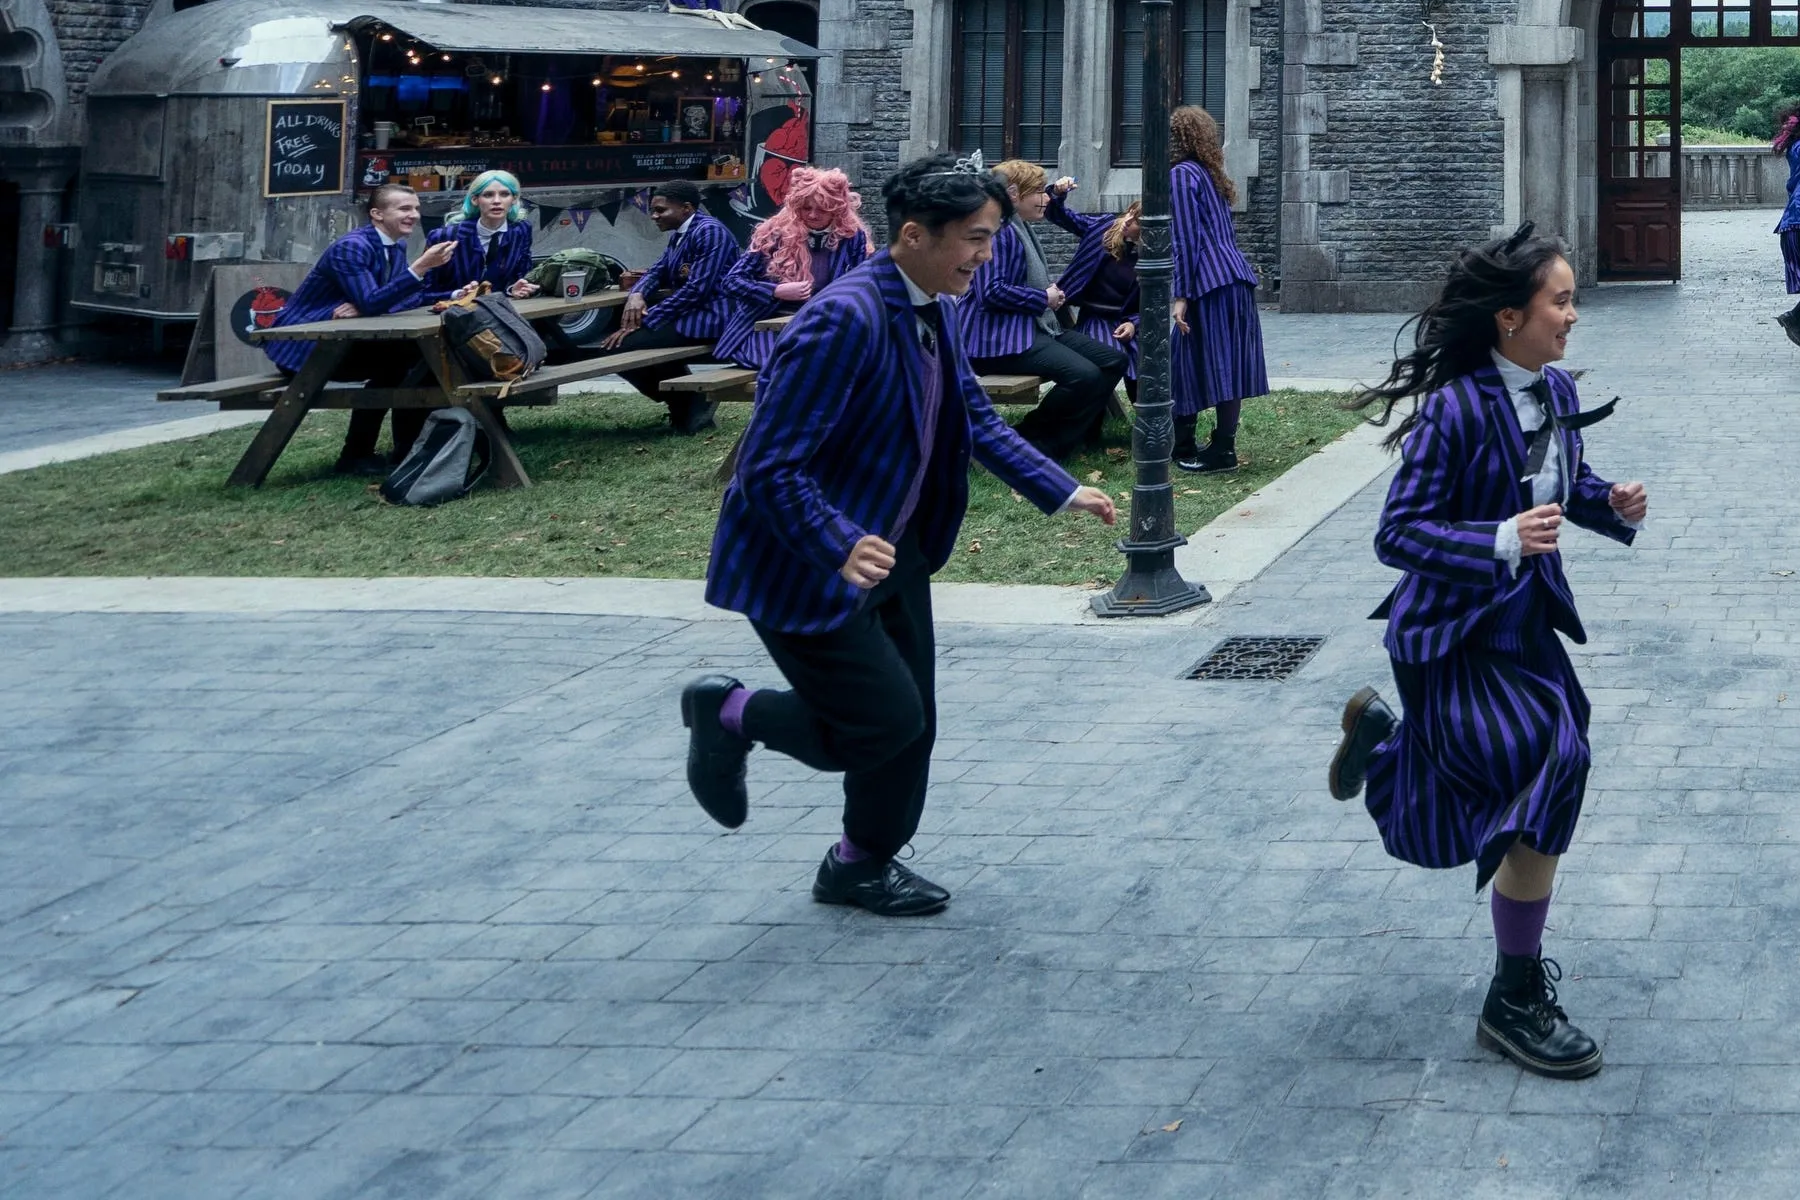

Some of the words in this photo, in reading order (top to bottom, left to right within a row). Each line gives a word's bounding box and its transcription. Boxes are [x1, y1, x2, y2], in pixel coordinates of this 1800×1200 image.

[275, 114, 304, 128] ALL
[304, 114, 341, 138] DRINKS
[274, 134, 311, 155] FREE
